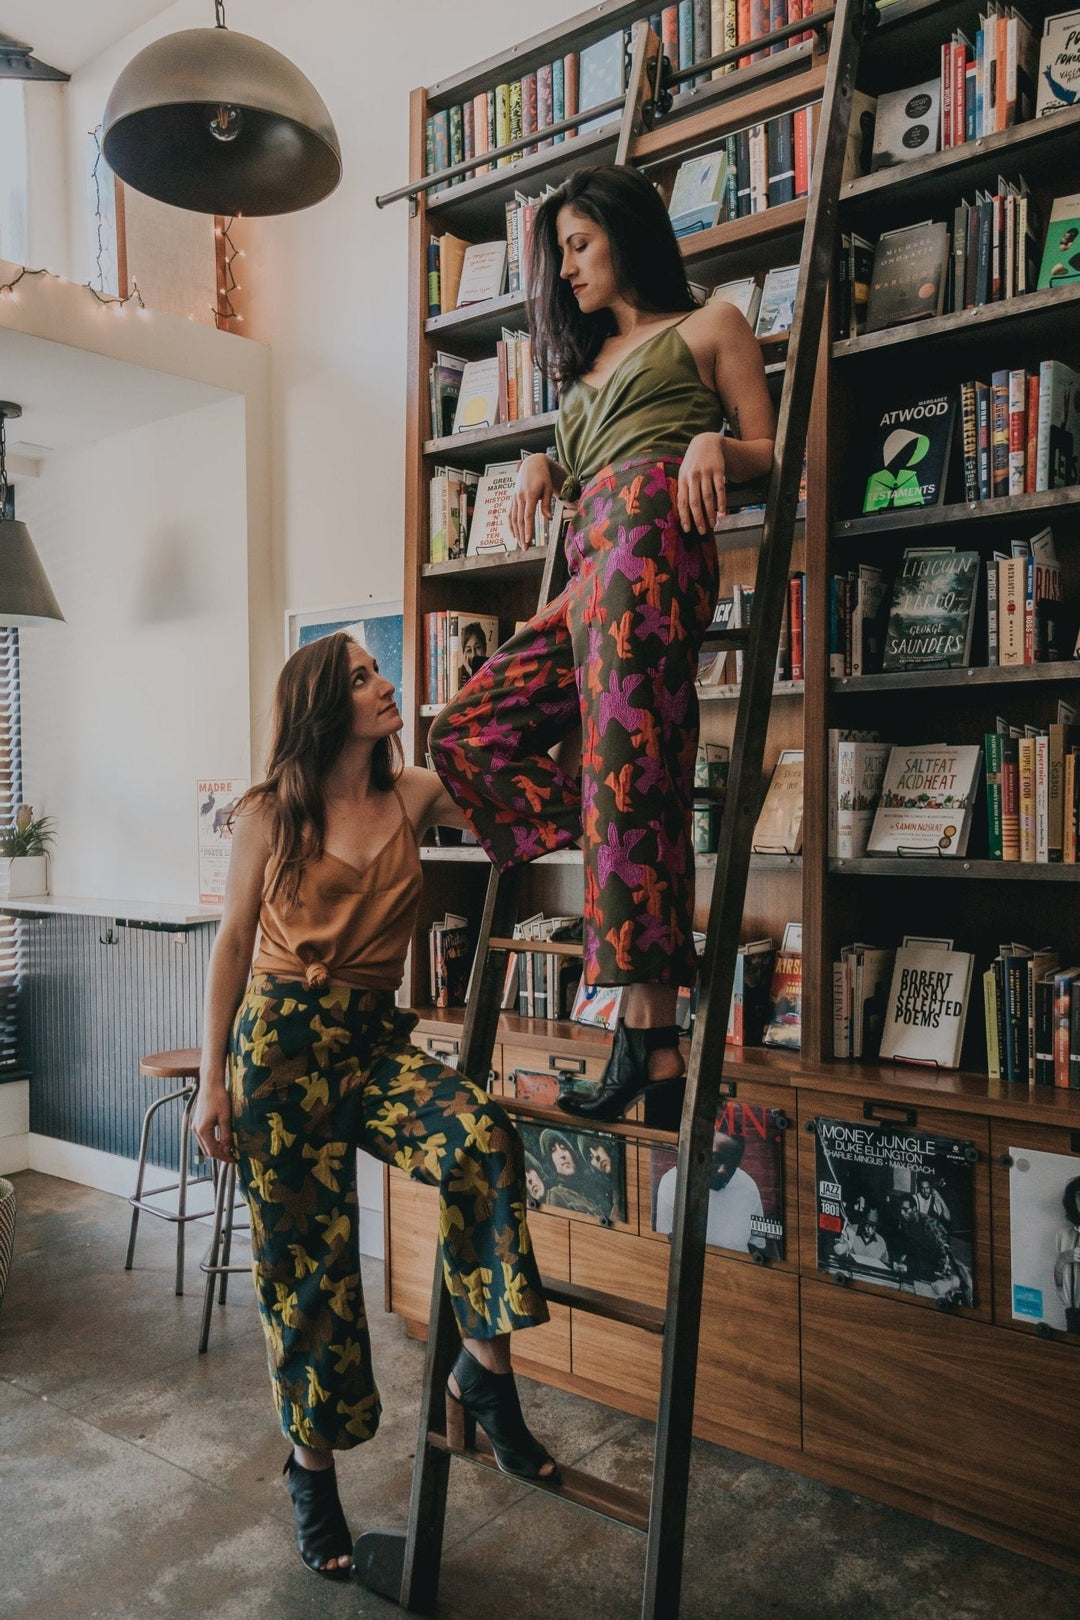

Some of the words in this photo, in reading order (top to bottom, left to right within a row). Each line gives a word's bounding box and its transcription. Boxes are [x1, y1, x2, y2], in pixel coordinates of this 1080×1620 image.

[918, 397, 948, 406] MARGARET
[962, 386, 976, 411] JEFF
[880, 402, 950, 427] ATWOOD
[963, 413, 977, 457] TWEEDY
[492, 477, 513, 485] GREIL
[484, 496, 511, 504] HISTOR
[867, 484, 936, 502] TESTAMENTS
[486, 520, 504, 528] ROLL
[480, 538, 504, 546] SONGS
[902, 557, 974, 578] LINCOLN
[1007, 563, 1015, 597] PATRIOTIC
[712, 603, 732, 623] ICK
[1025, 615, 1033, 632] BOSS
[909, 622, 944, 637] GEORGE
[888, 634, 964, 655] SAUNDERS
[1023, 745, 1031, 774] HIPPIE
[1037, 743, 1046, 785] Repertoire
[199, 782, 233, 793] MADRE
[1023, 776, 1031, 799] FOOD
[1050, 761, 1062, 799] Season
[895, 822, 917, 832] SAMIN
[901, 969, 954, 988] ROBERT
[834, 970, 843, 1020] INFERNO
[900, 980, 948, 1001] PINSKY
[896, 994, 963, 1017] SELECTED
[894, 1007, 940, 1029] POEMS
[822, 1124, 874, 1144] MONEY
[876, 1135, 936, 1156] JUNGLE
[824, 1150, 853, 1161] CHARLIE
[853, 1154, 884, 1167] MINGUS
[889, 1161, 906, 1171] MAX
[906, 1163, 936, 1175] ROACH
[835, 1140, 864, 1155] DUKE
[865, 1145, 923, 1165] ELLINGTON
[820, 1183, 840, 1197] JAZZ
[751, 1221, 782, 1235] ADVISORY
